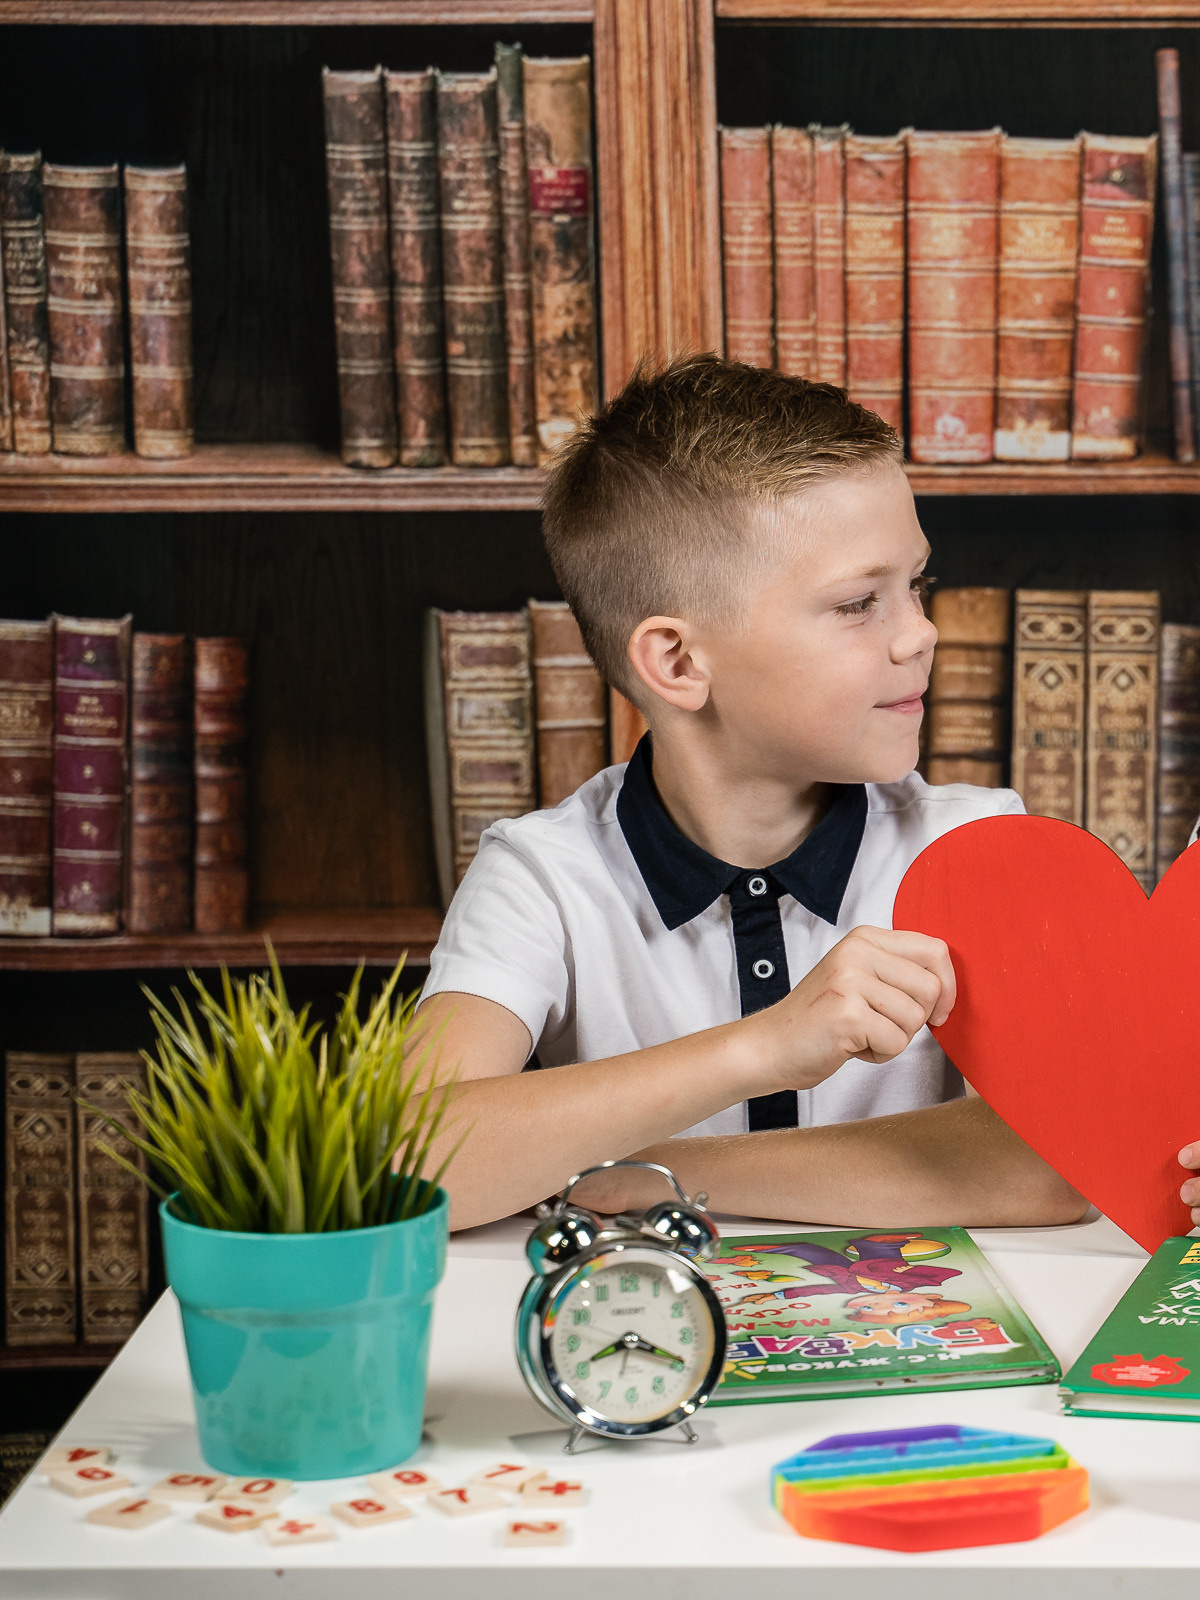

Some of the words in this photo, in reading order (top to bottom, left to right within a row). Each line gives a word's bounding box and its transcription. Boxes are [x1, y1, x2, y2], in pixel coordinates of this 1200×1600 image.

[620, 1275, 640, 1292] 12
[652, 1281, 661, 1296] 1
[573, 1308, 591, 1325] 10
[671, 1301, 683, 1318] 2
[727, 1317, 831, 1331] МА-М
[567, 1334, 580, 1353] 9
[679, 1326, 692, 1345] 3
[576, 1361, 590, 1379] 8
[740, 1357, 891, 1374] ЖУКОВА
[598, 1380, 612, 1400] 7
[652, 1376, 665, 1394] 5
[625, 1386, 638, 1403] 6
